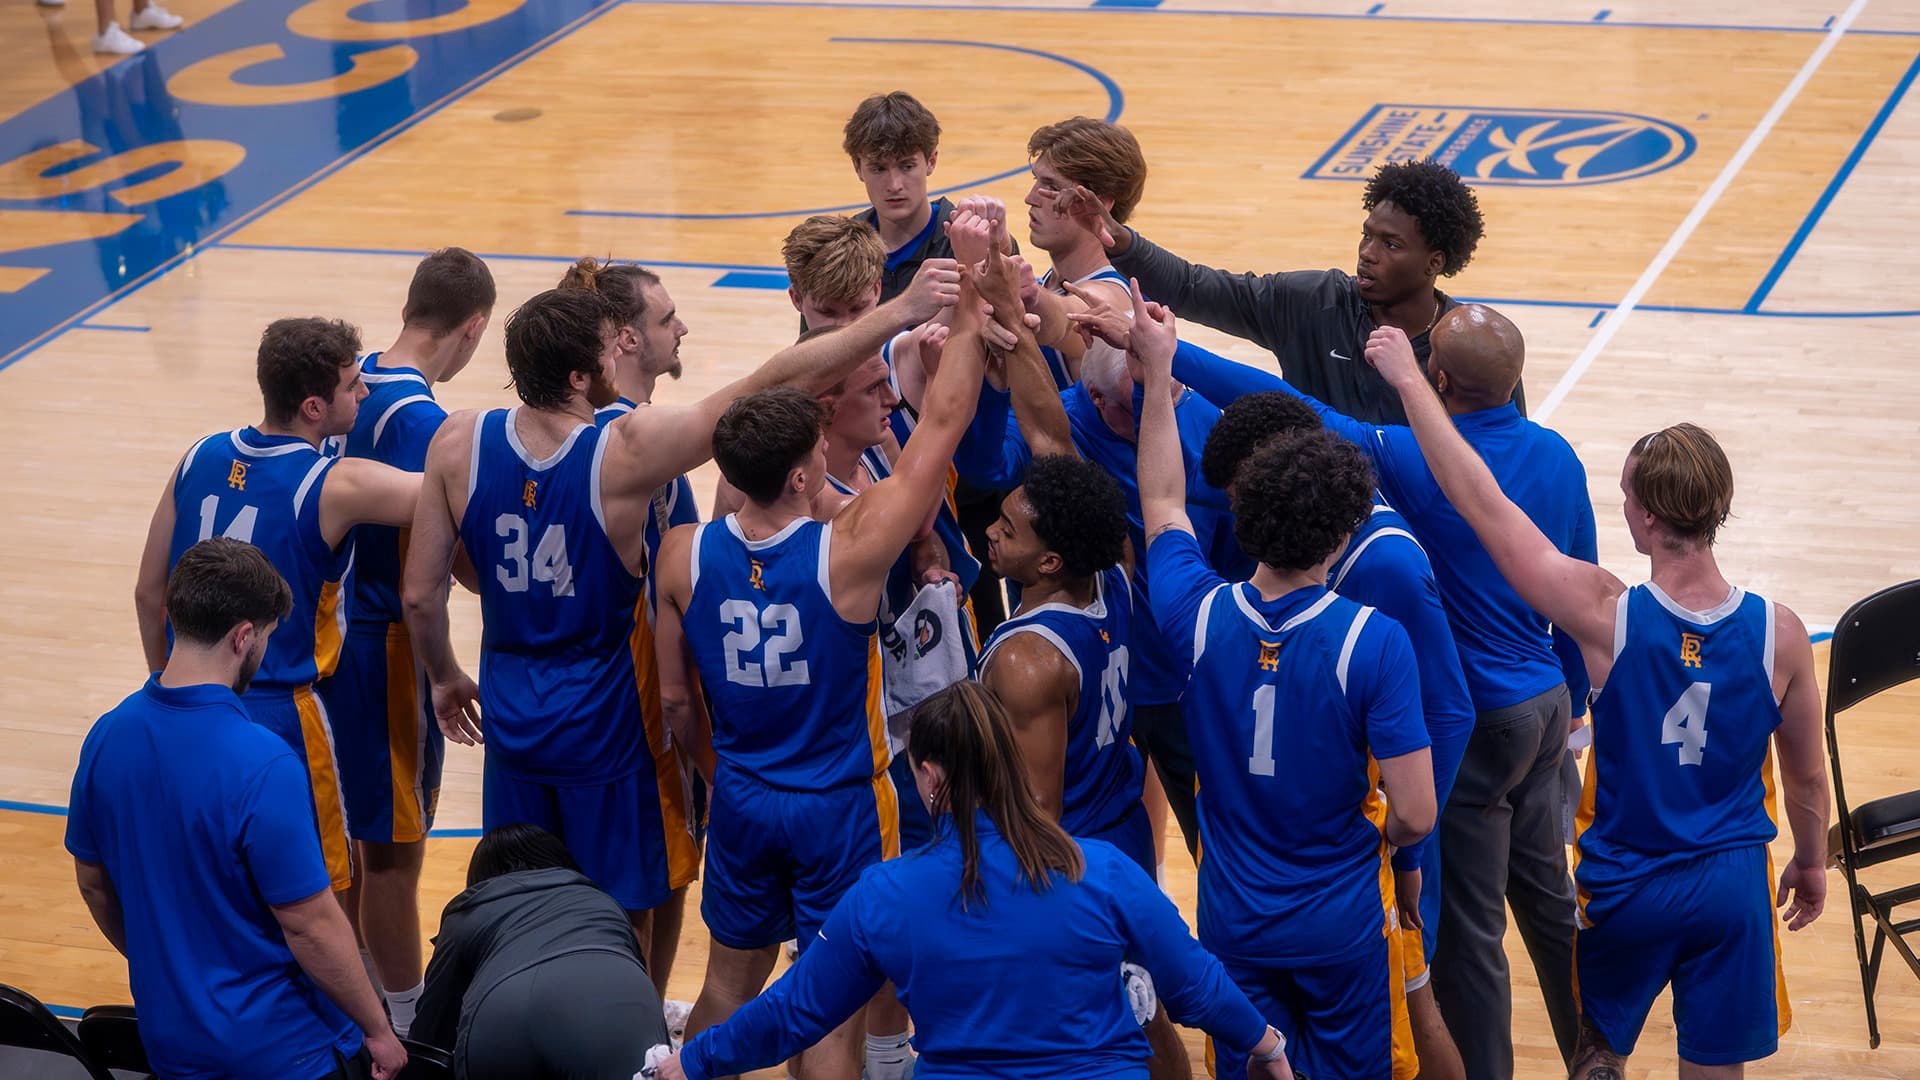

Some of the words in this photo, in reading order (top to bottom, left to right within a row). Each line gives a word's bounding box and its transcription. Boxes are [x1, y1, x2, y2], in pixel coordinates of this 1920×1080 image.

[1332, 110, 1420, 173] SUNSHINE
[1386, 124, 1446, 166] STATE
[495, 513, 575, 597] 34
[719, 599, 811, 688] 22
[1249, 684, 1276, 776] 1
[1661, 681, 1711, 765] 4
